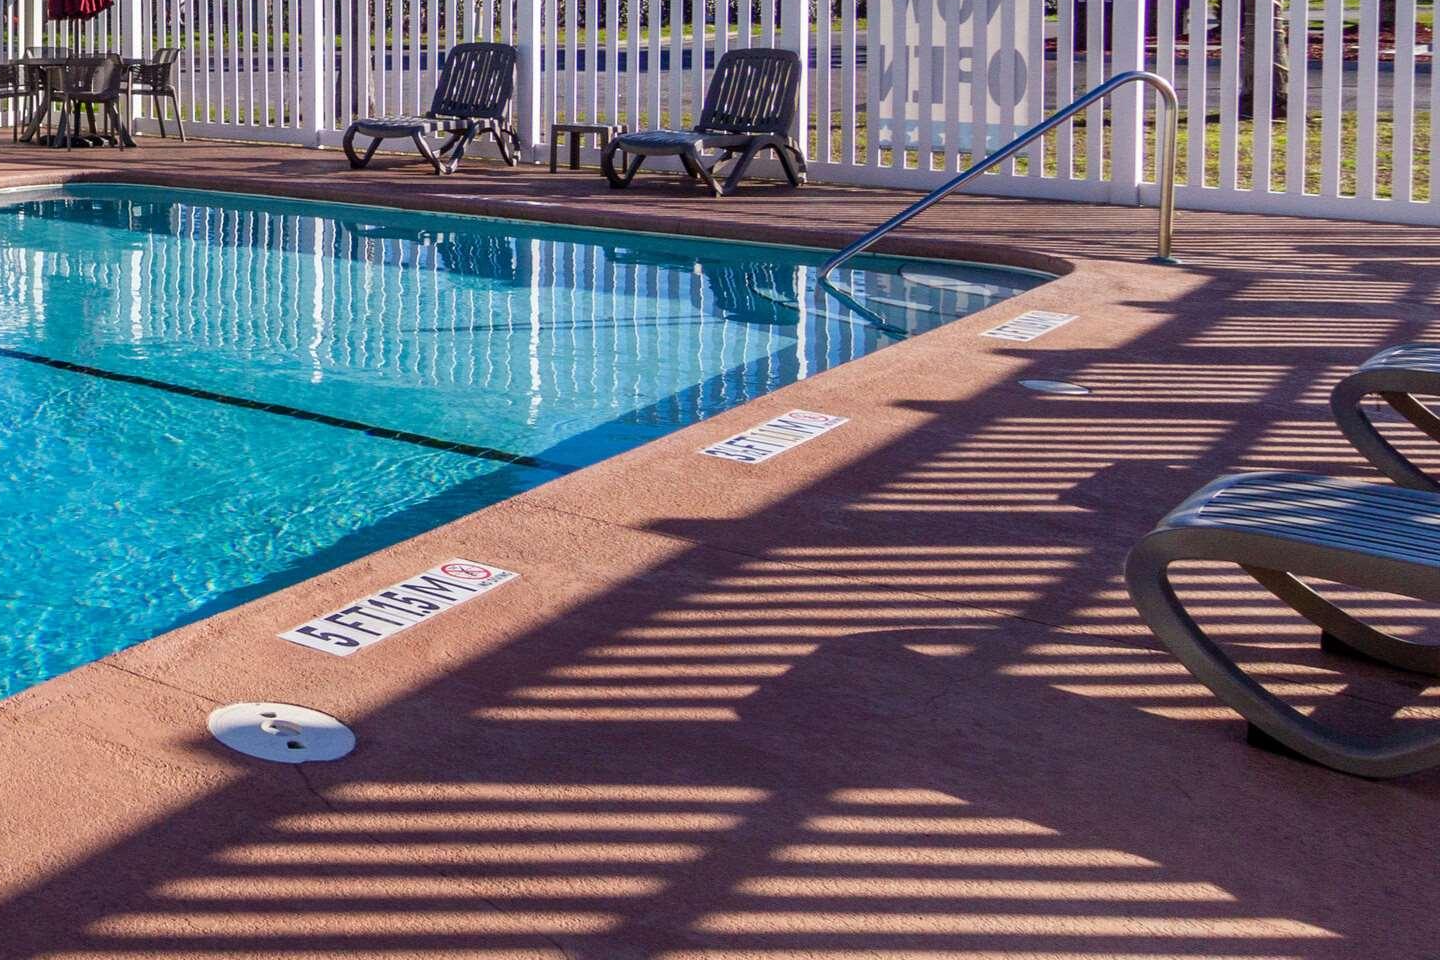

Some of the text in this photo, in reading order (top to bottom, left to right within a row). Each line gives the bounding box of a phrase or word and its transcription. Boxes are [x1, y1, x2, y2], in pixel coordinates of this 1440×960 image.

[766, 419, 826, 435] M
[296, 575, 478, 648] 5 FT 1.5 M
